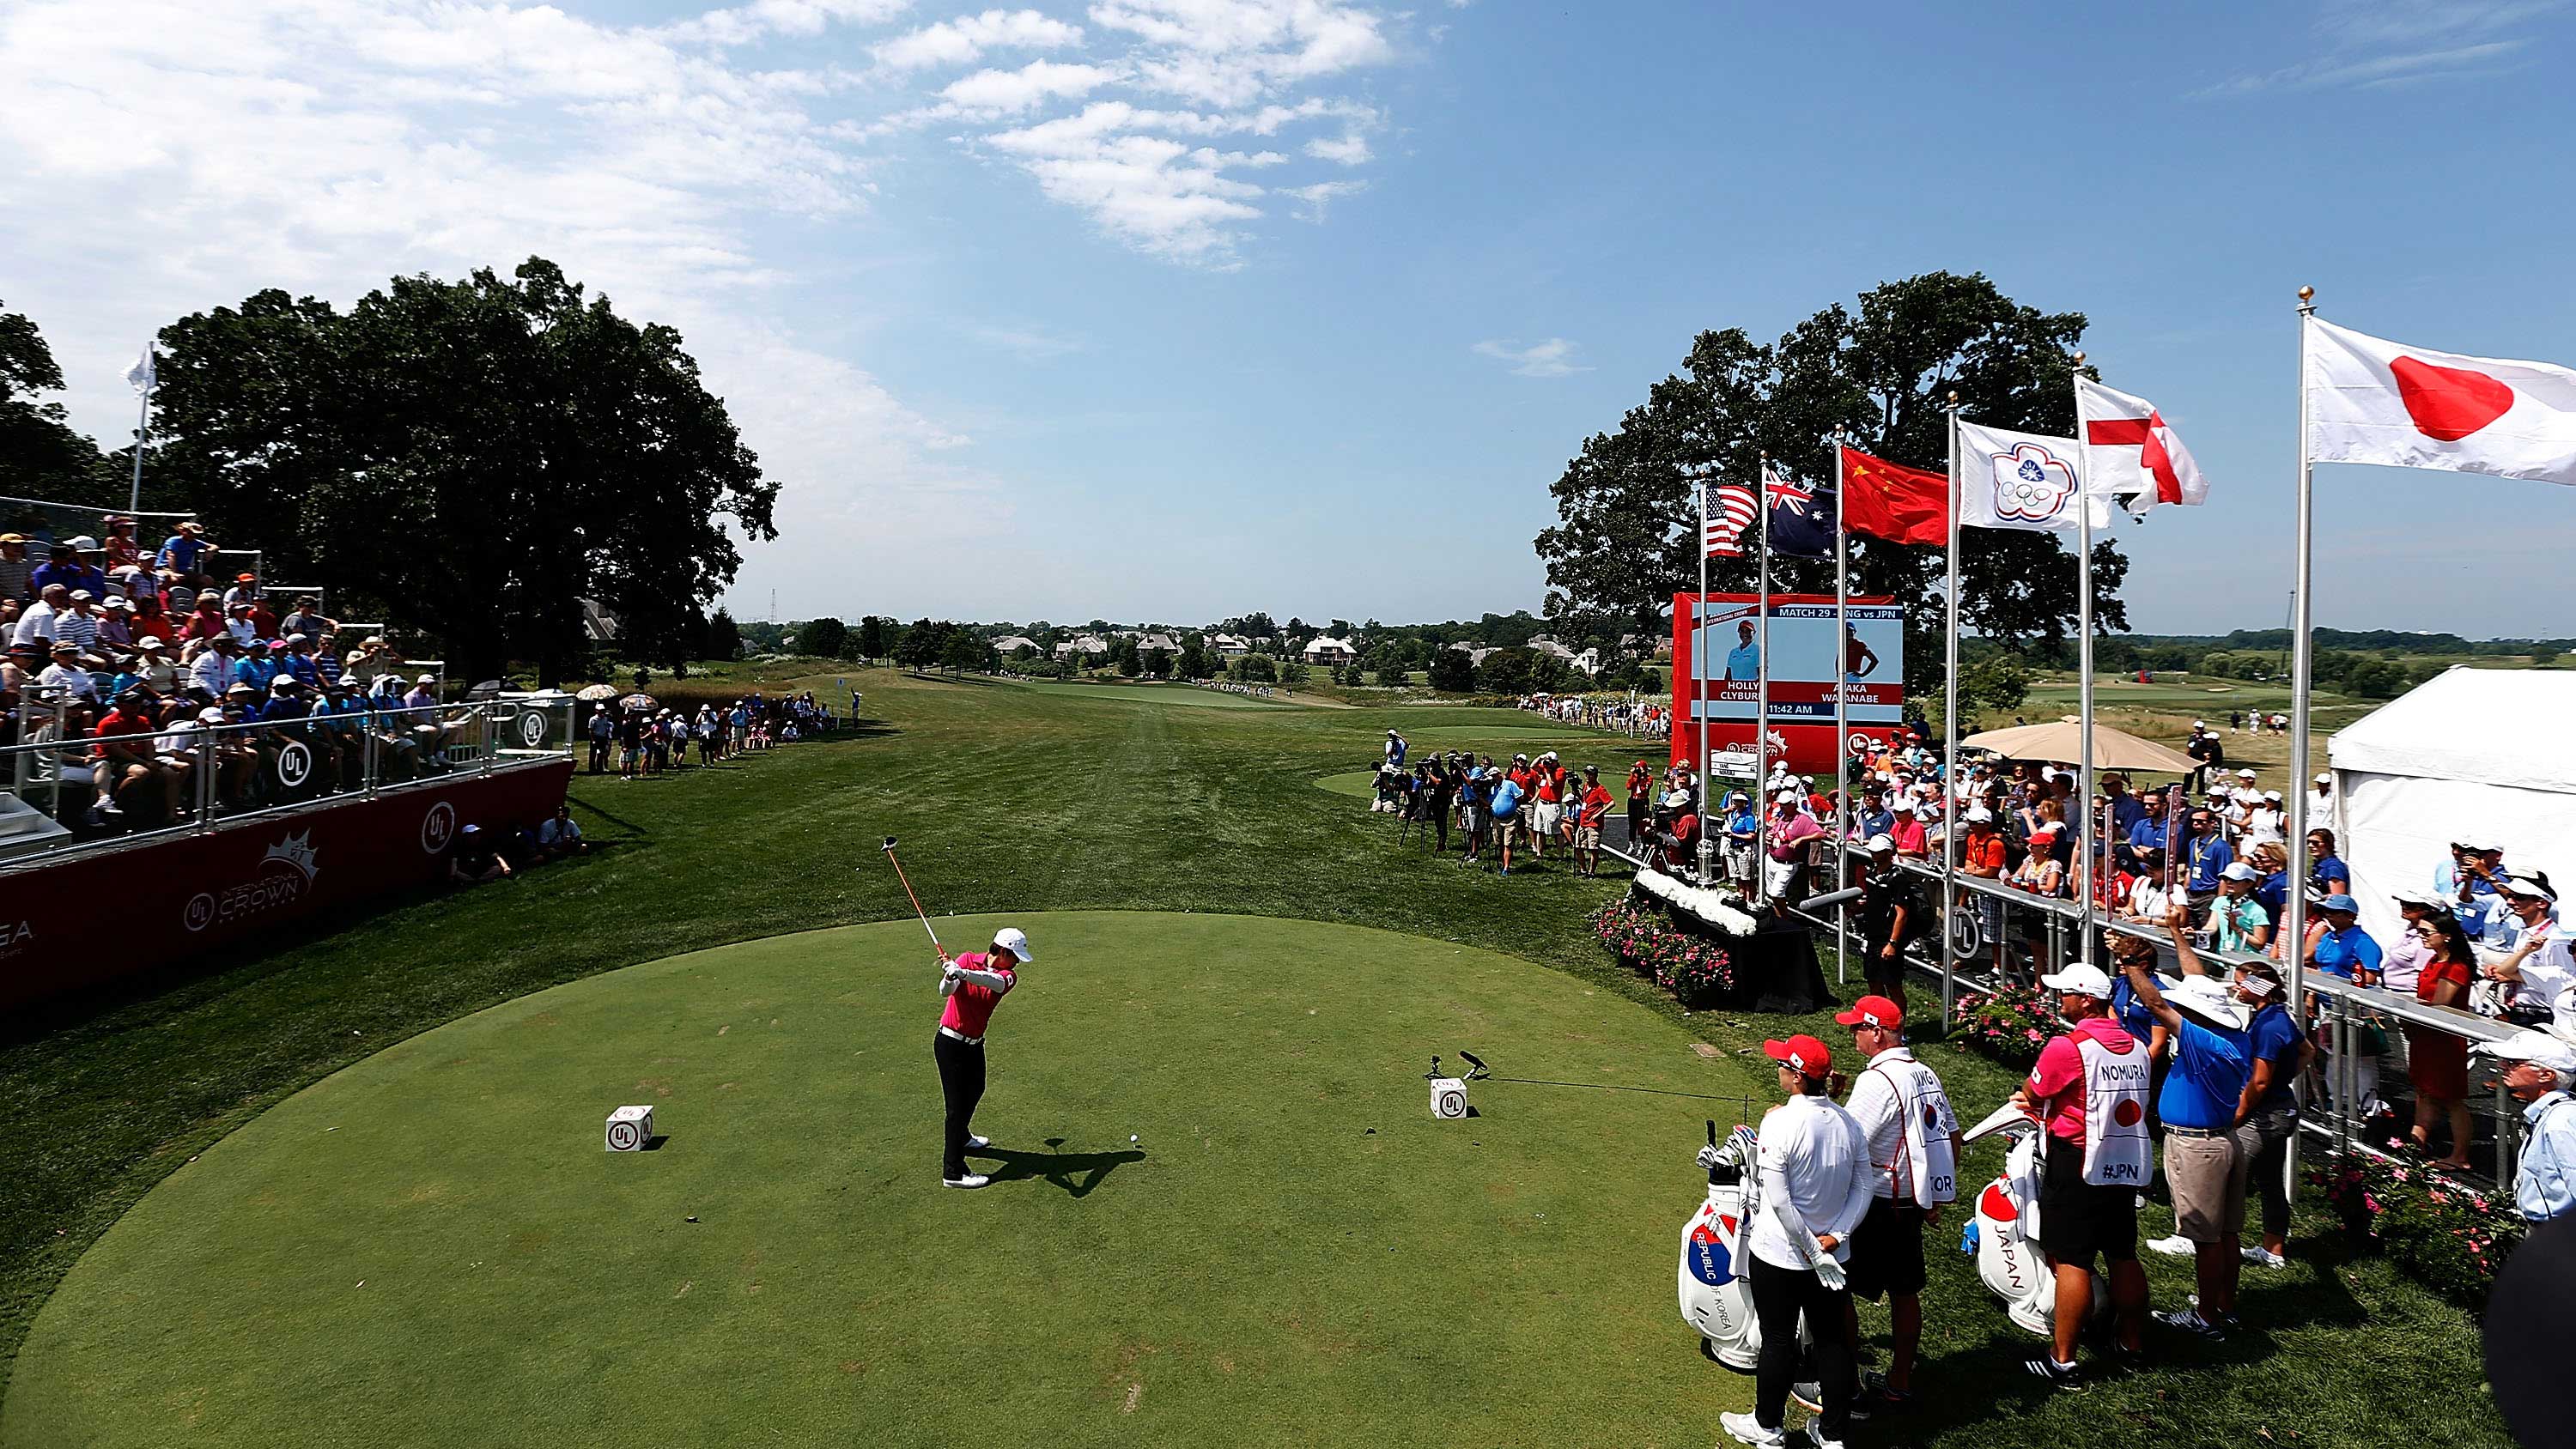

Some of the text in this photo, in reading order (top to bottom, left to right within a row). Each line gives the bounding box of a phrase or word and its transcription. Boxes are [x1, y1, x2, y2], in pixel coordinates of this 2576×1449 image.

[1779, 609, 1815, 617] MATCH
[1819, 609, 1831, 617] 29
[1876, 610, 1896, 619] JPN
[1728, 681, 1759, 690] HOLLY
[1833, 683, 1867, 694] AAKA
[1720, 691, 1760, 700] CLYBUR
[1821, 694, 1879, 704] WAANABE
[1769, 705, 1813, 714] 11:42 AM
[528, 721, 538, 738] UL
[286, 752, 303, 776] UL
[430, 813, 446, 842] UL
[191, 878, 300, 922] UL CROWN
[1953, 915, 1971, 949] UL
[2101, 1064, 2147, 1081] NOMURA
[1445, 1096, 1460, 1112] UL
[615, 1127, 631, 1144] UL
[2102, 1163, 2139, 1180] #JPN
[1995, 1225, 2025, 1289] JAPAN
[1695, 1232, 1732, 1330] REPUBLIC OF KOREA
